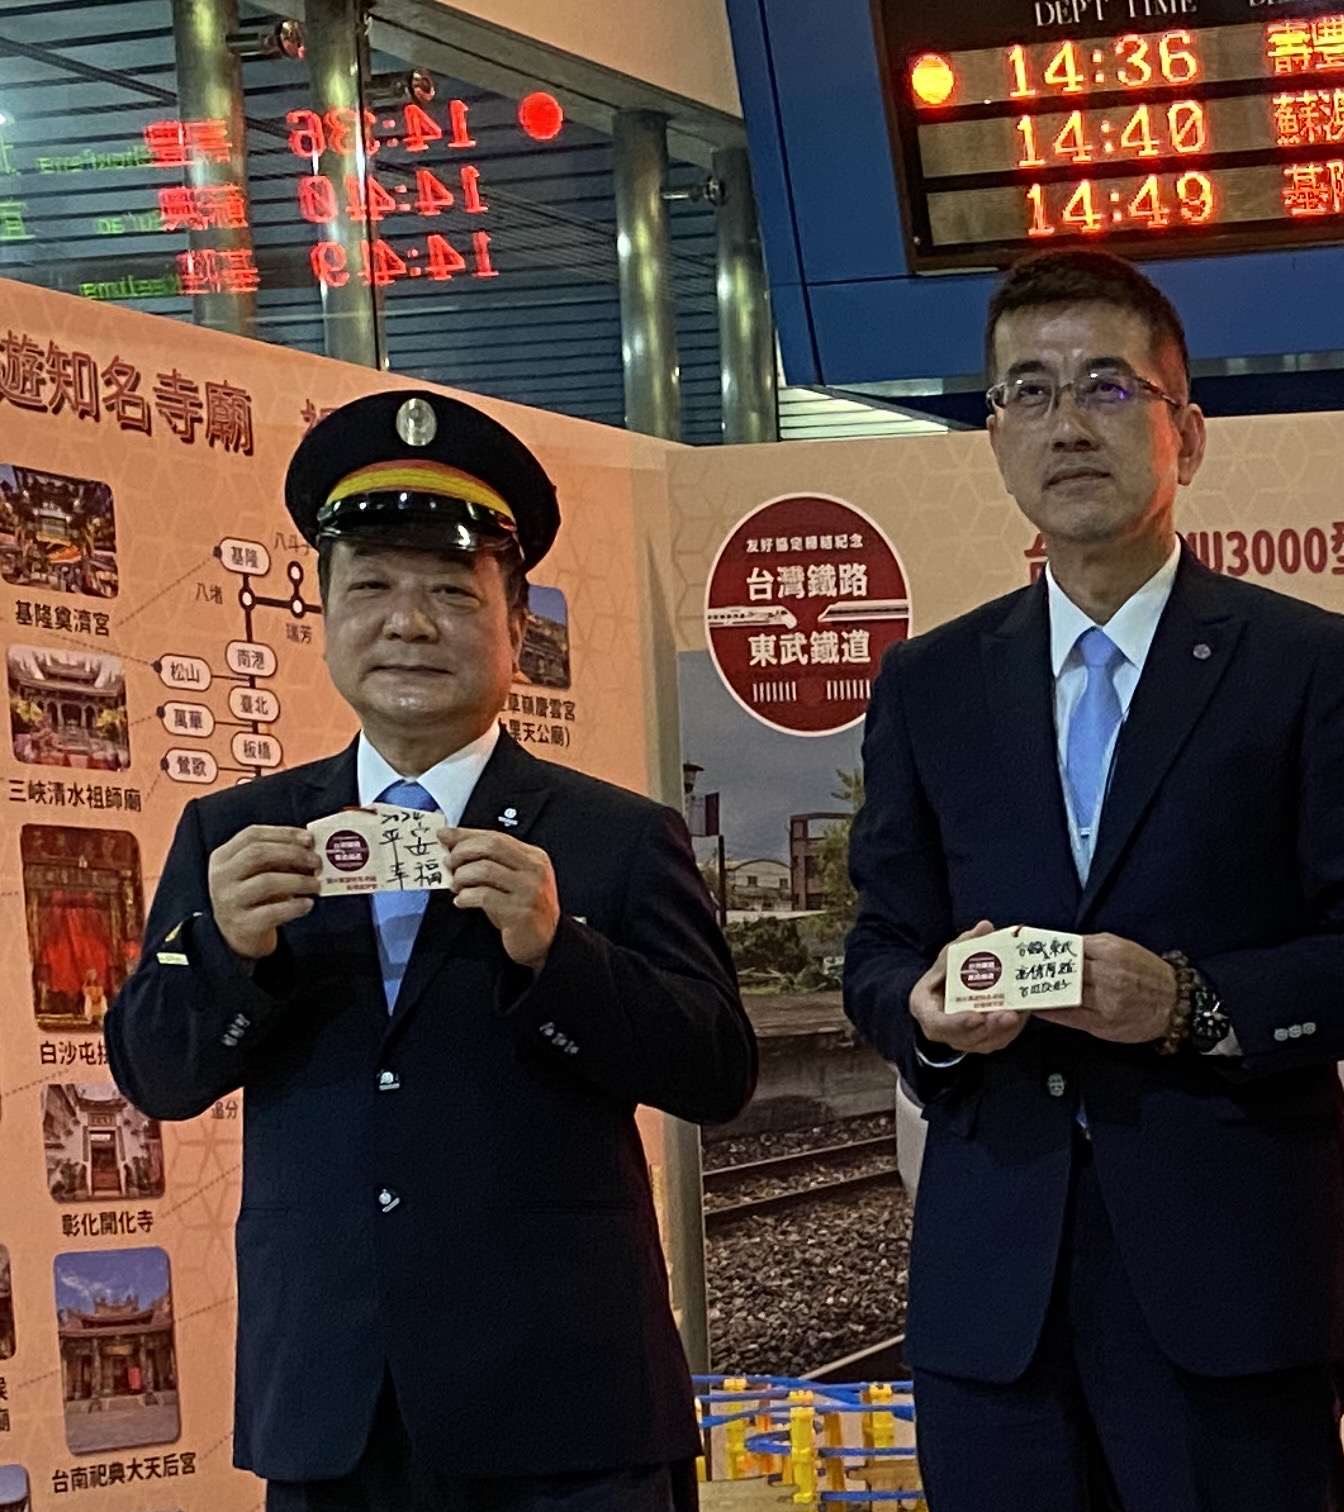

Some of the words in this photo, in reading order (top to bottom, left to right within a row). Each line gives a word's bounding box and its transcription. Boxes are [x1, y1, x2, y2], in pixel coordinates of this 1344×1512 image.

[1008, 29, 1198, 98] 14:36
[1016, 99, 1208, 168] 14:40
[1026, 171, 1213, 237] 14:49
[0, 329, 254, 457] 遊知名寺廟
[231, 546, 260, 570] 基隆
[746, 563, 868, 601] 台灣鐵路
[748, 630, 872, 667] 東武鐵道
[170, 661, 200, 684] 松山
[173, 708, 204, 730] 萬華
[240, 693, 269, 716] 臺北
[243, 739, 272, 761] 板橋
[9, 779, 143, 813] 三峽清水祖師廟
[62, 1210, 154, 1238] 彰化開化寺
[52, 1453, 197, 1494] 台南祀典大天后宮
